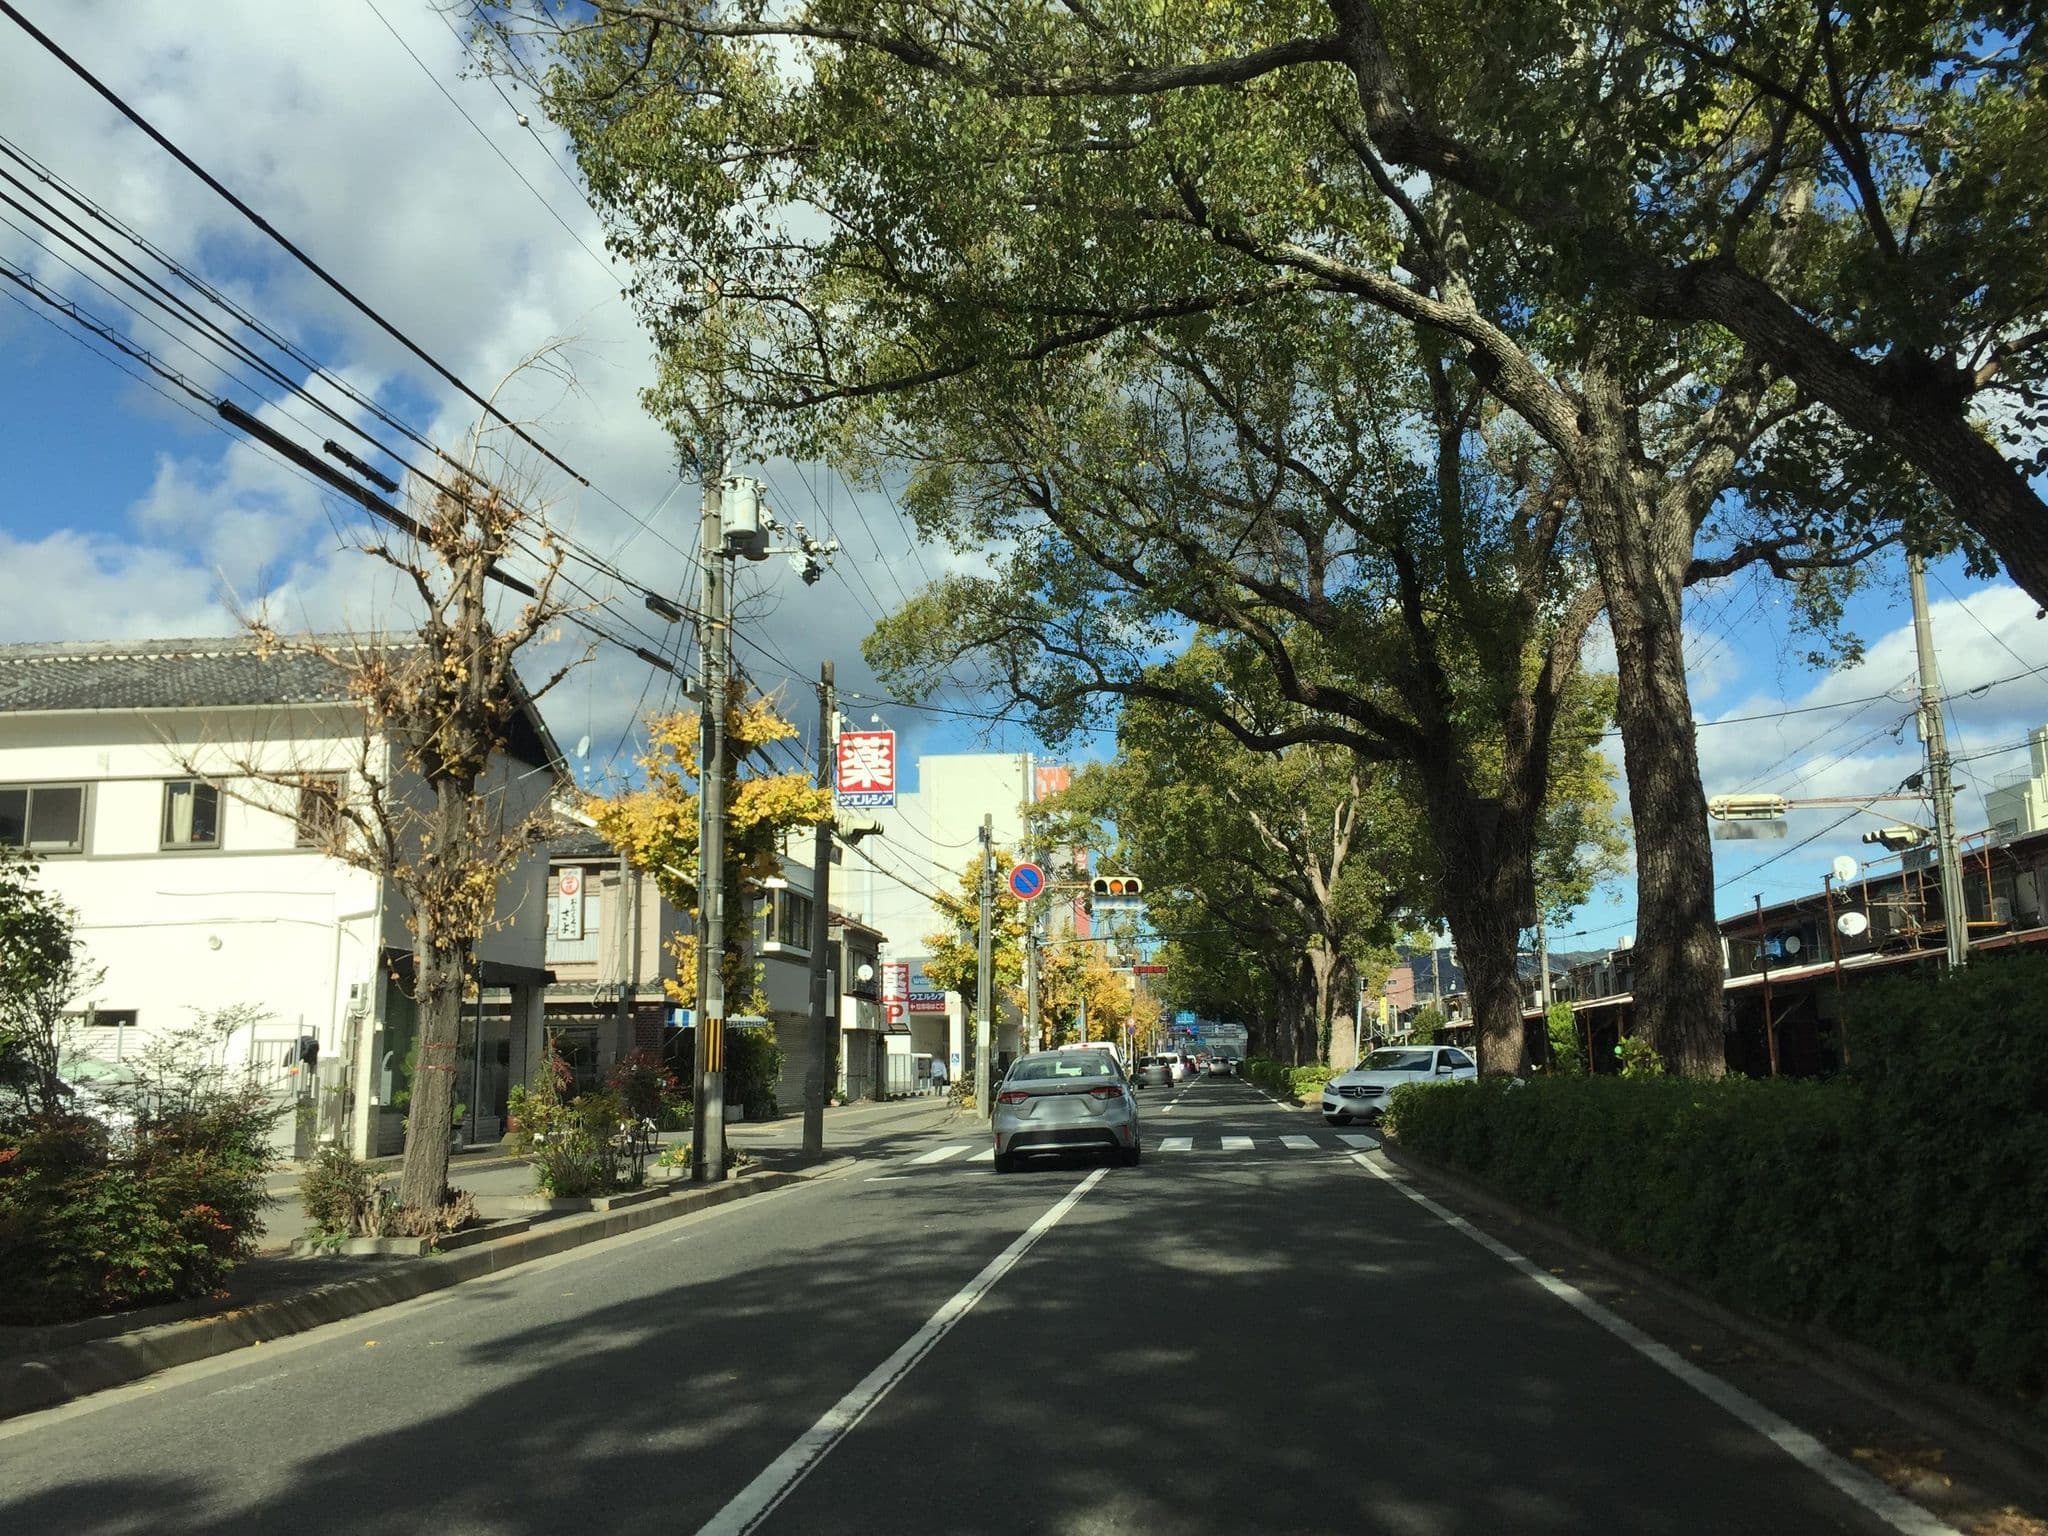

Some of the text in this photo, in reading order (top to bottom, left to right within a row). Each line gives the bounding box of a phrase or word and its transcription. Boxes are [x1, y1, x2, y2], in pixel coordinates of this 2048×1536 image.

[841, 737, 892, 788] 薬
[840, 794, 892, 806] ウエルシア
[883, 967, 907, 1001] 薬
[909, 993, 945, 1001] ウエルシア
[887, 1004, 904, 1024] P
